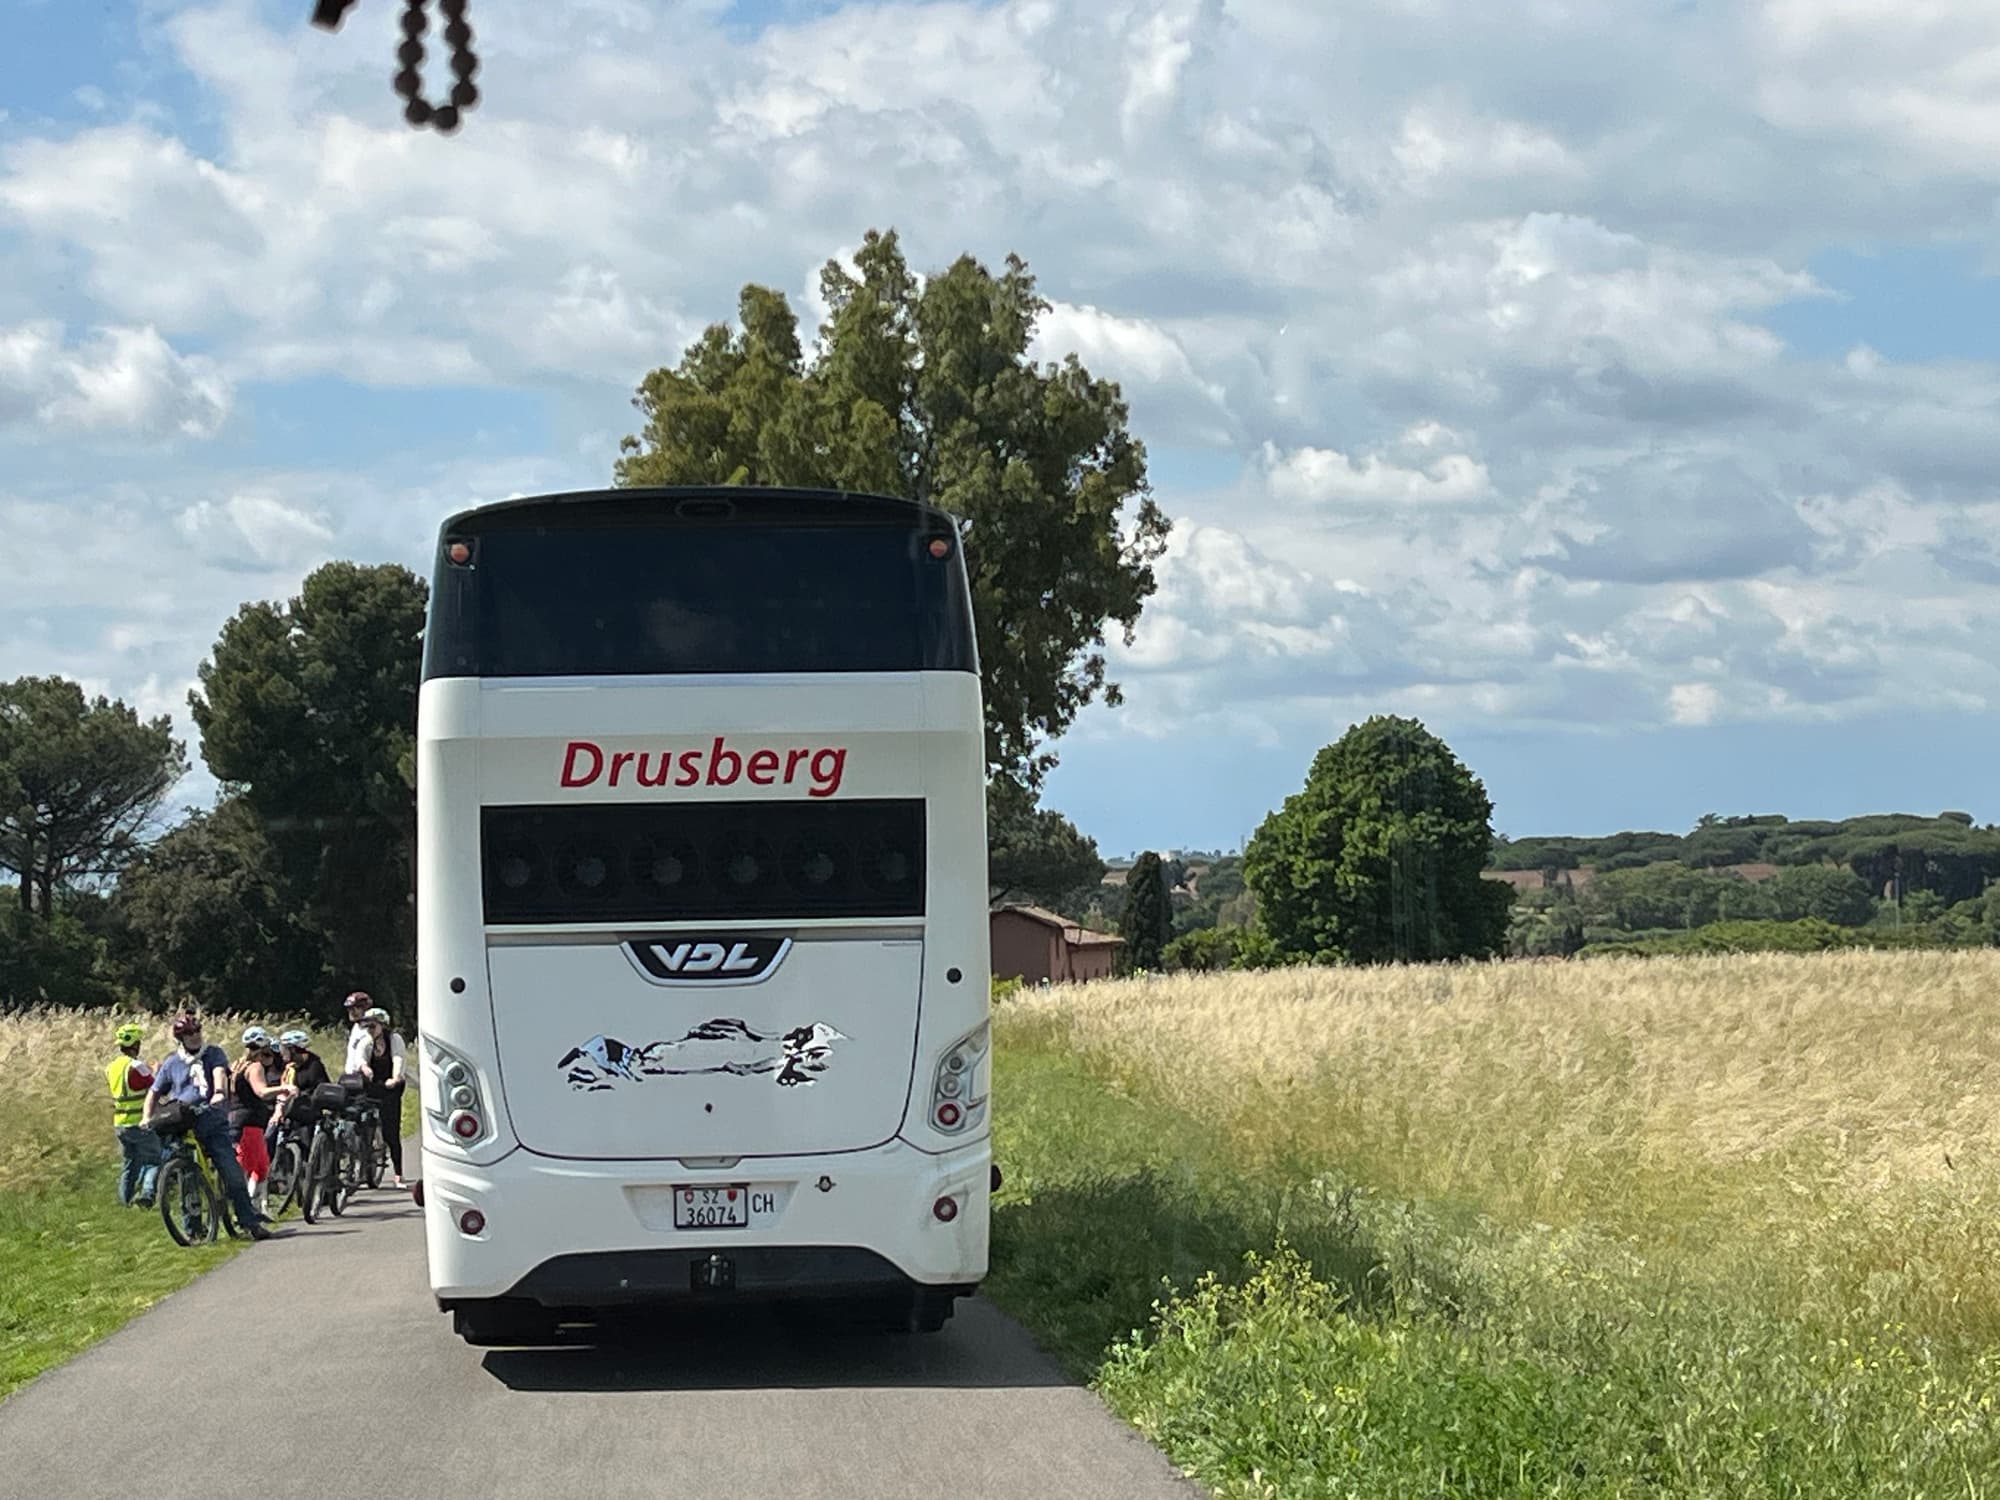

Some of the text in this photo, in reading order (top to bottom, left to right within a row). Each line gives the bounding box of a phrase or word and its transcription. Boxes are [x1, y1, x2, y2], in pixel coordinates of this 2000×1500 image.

[560, 737, 847, 797] Drusberg
[650, 943, 759, 972] VDL
[702, 1189, 719, 1204] SZ
[752, 1193, 775, 1213] CH
[686, 1206, 737, 1225] 36074
